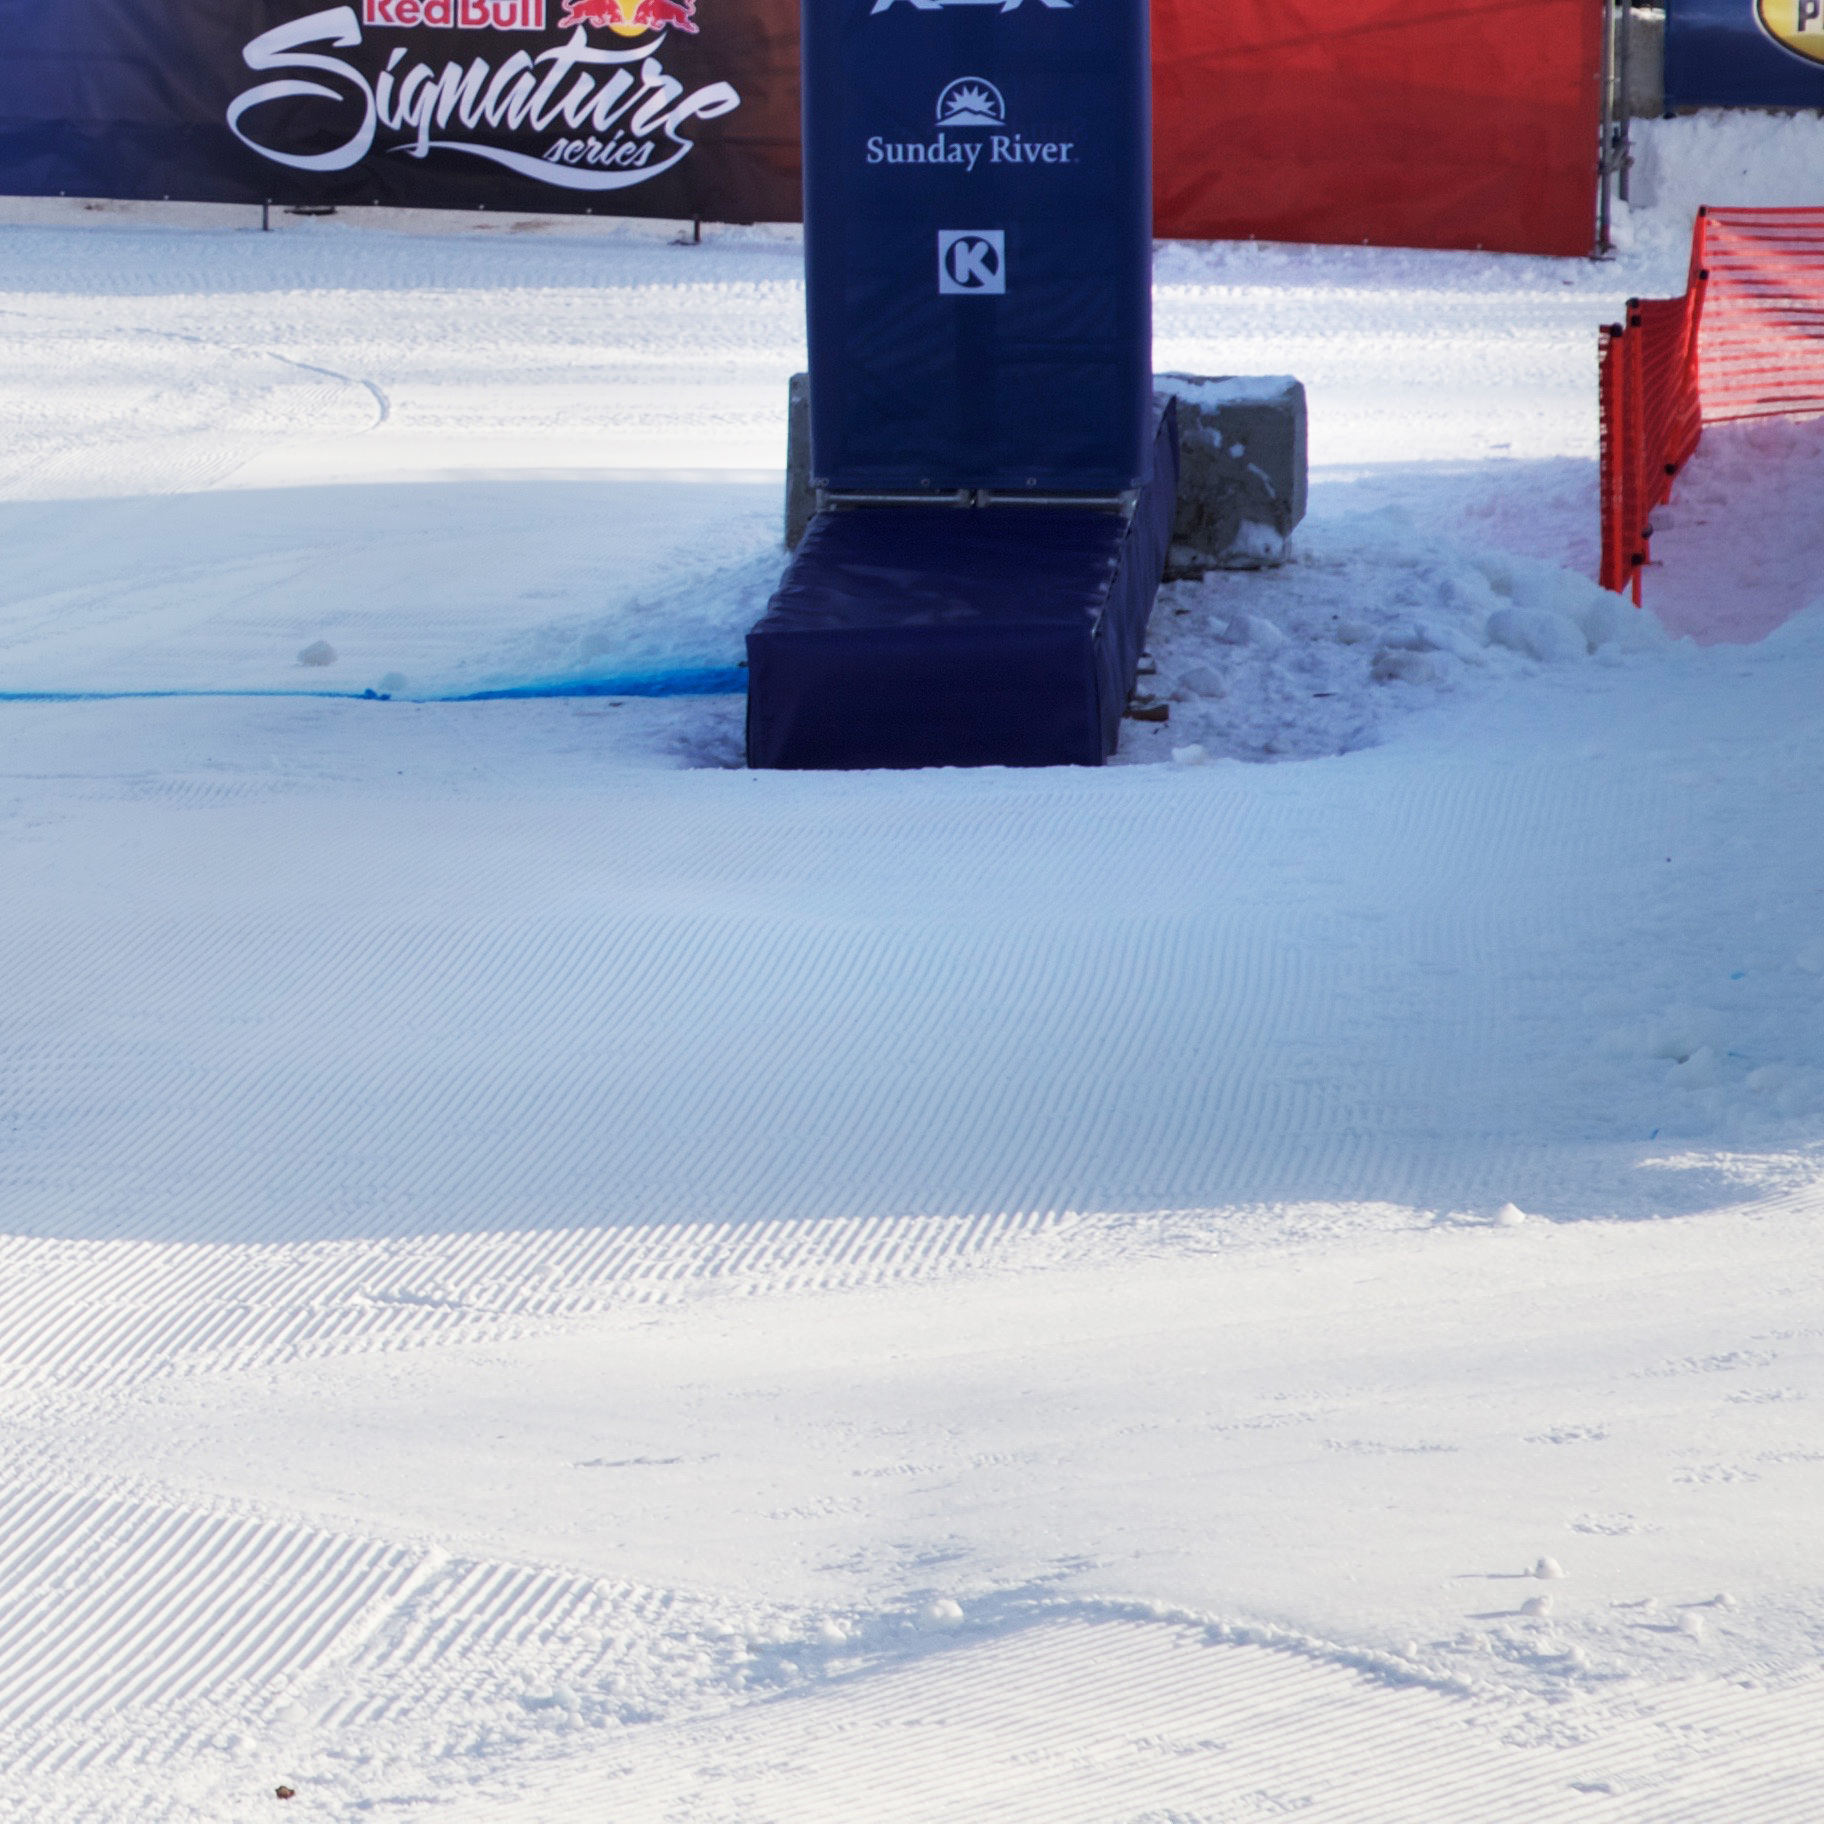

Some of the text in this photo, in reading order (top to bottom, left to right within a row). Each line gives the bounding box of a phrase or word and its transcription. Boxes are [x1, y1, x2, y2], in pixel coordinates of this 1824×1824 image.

[226, 5, 741, 191] Signature
[543, 131, 656, 169] series
[866, 132, 1075, 173] Sunday River
